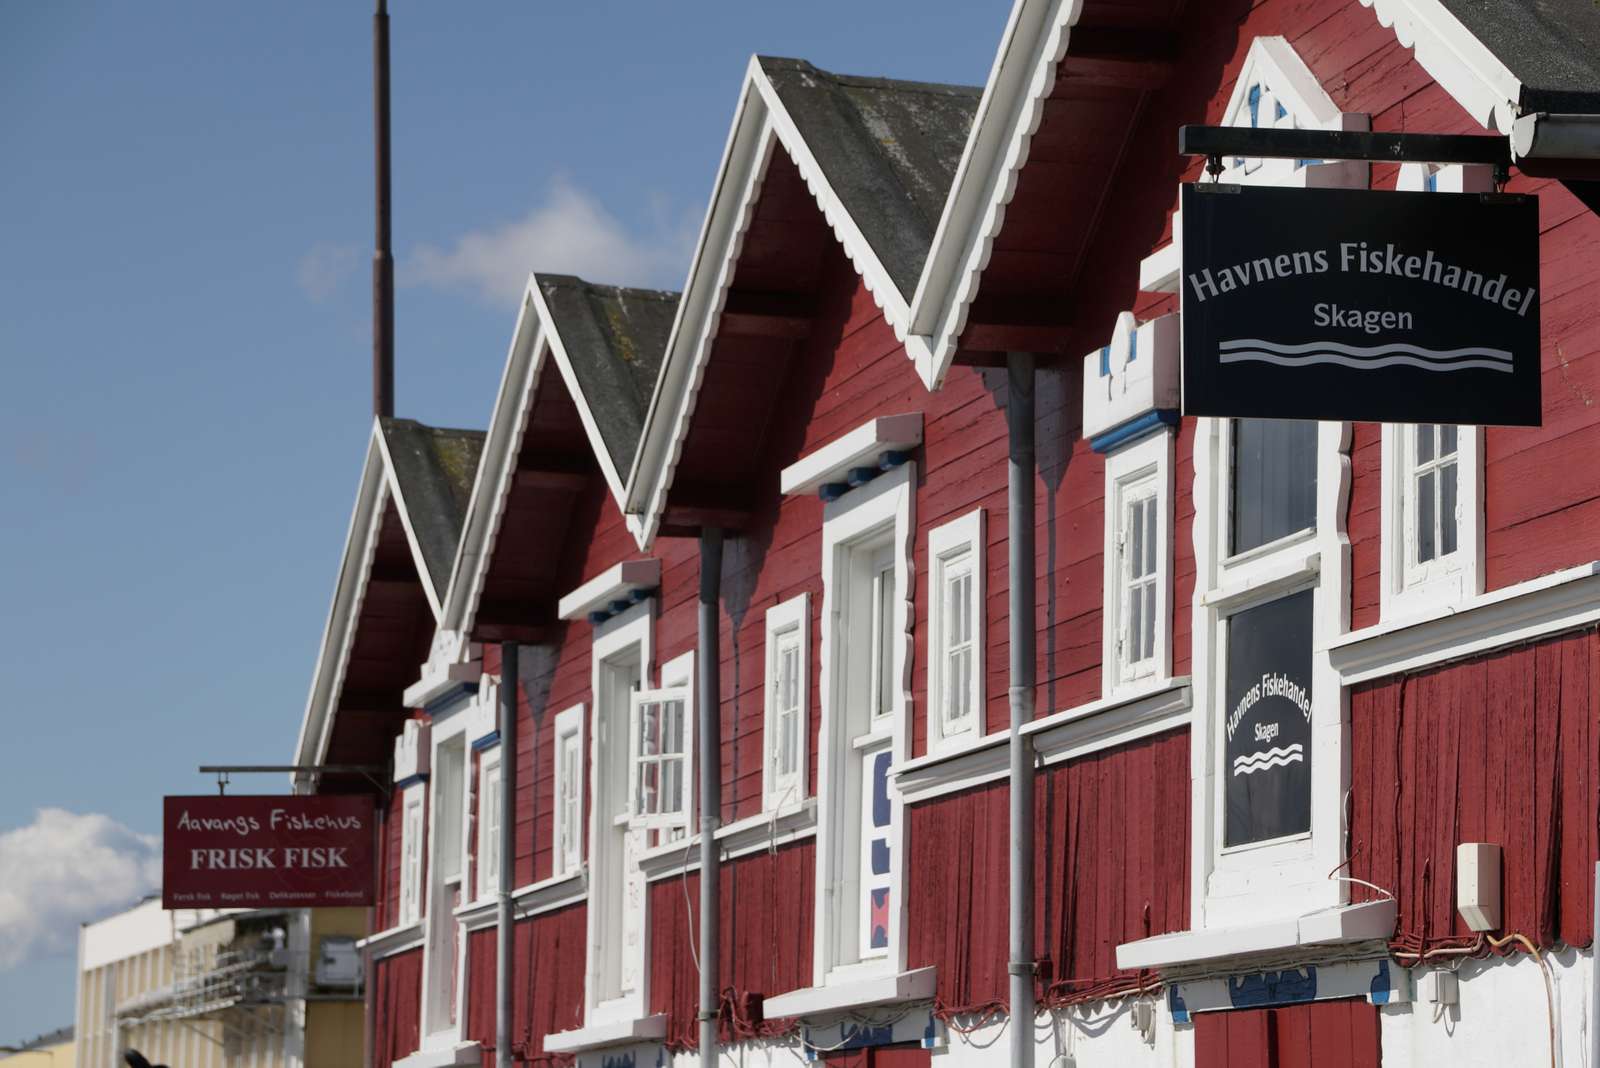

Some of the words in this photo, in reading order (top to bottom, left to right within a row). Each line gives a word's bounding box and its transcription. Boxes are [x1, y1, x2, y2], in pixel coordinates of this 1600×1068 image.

[1189, 249, 1329, 303] Havnens
[1340, 241, 1536, 317] Fiskehandel
[1313, 303, 1414, 334] Skagen
[1226, 683, 1260, 742] Havnens
[1262, 672, 1312, 723] Fiskehandel
[1254, 722, 1279, 743] Skagen
[177, 810, 260, 835] Aavangs
[270, 808, 362, 830] Fiskehus
[191, 848, 276, 869] FRISK
[284, 847, 348, 868] FISK
